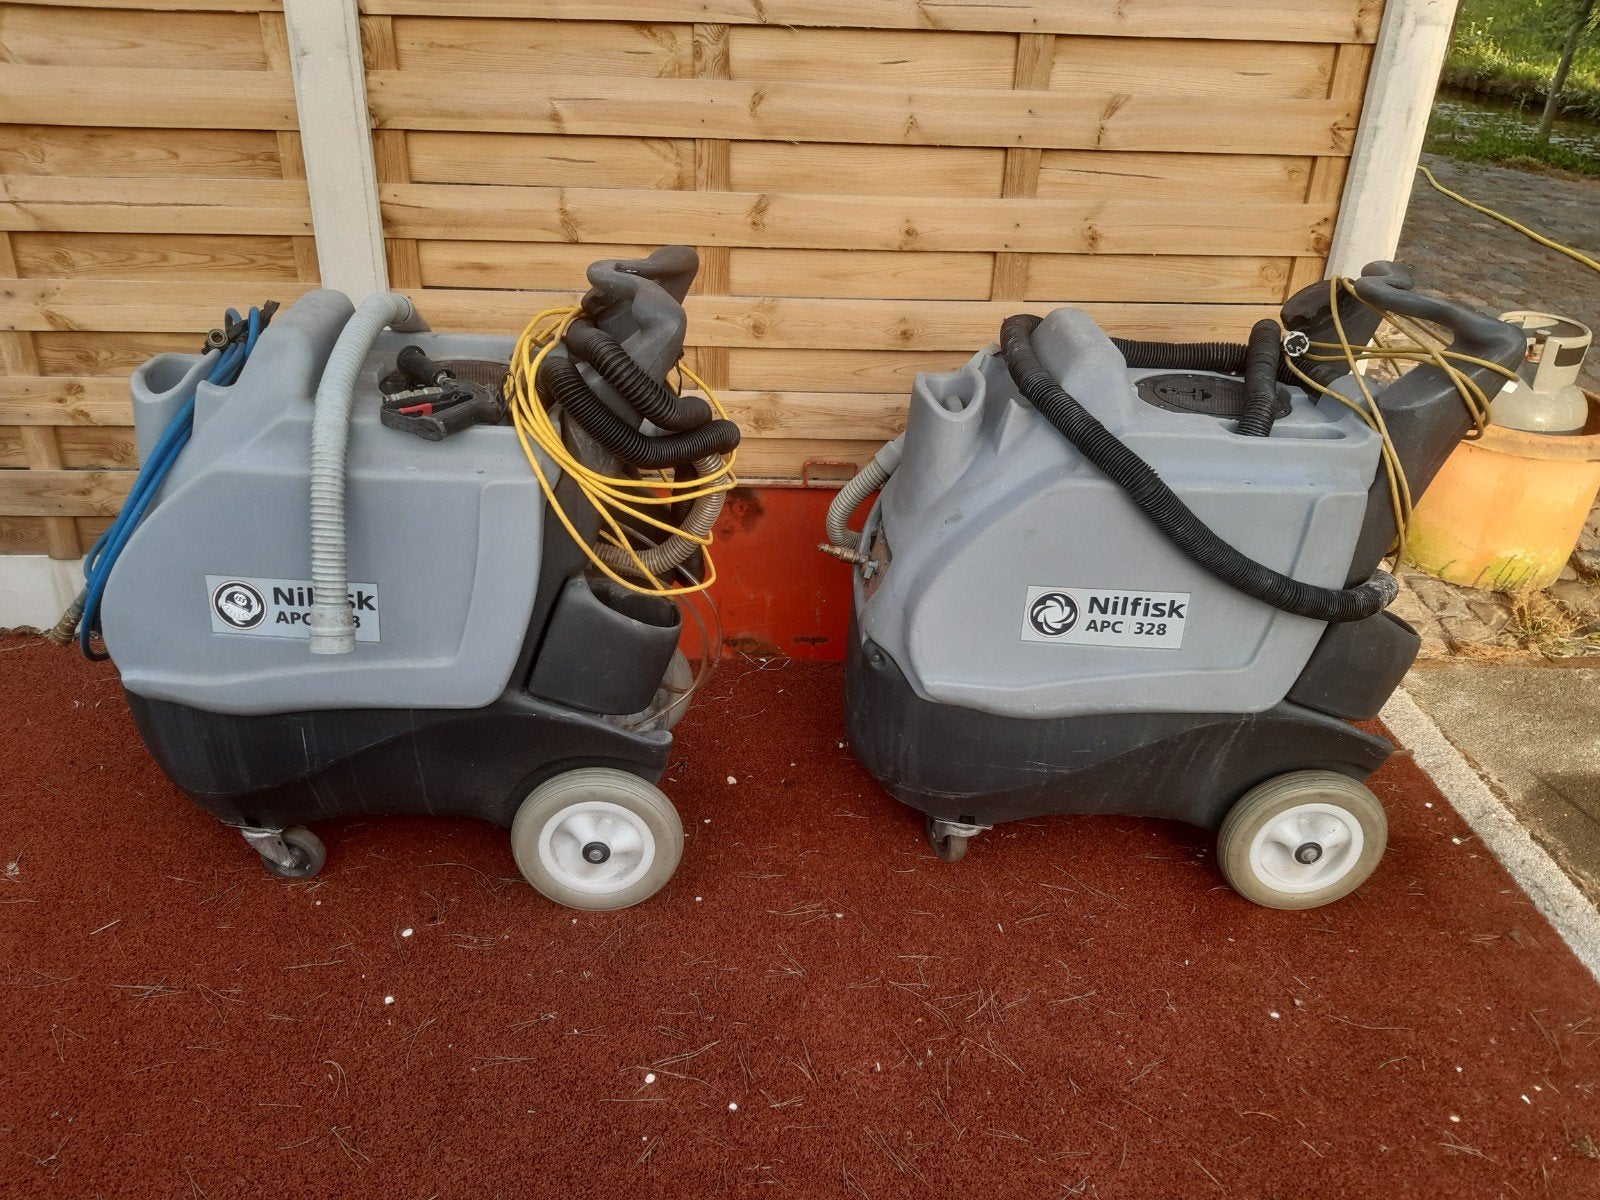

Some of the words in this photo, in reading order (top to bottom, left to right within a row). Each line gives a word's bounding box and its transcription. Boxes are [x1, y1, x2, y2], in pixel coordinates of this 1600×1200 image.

[273, 587, 376, 611] Nilsk
[1088, 596, 1186, 618] Nilfisk
[1085, 620, 1124, 634] APC
[1133, 621, 1167, 636] 328
